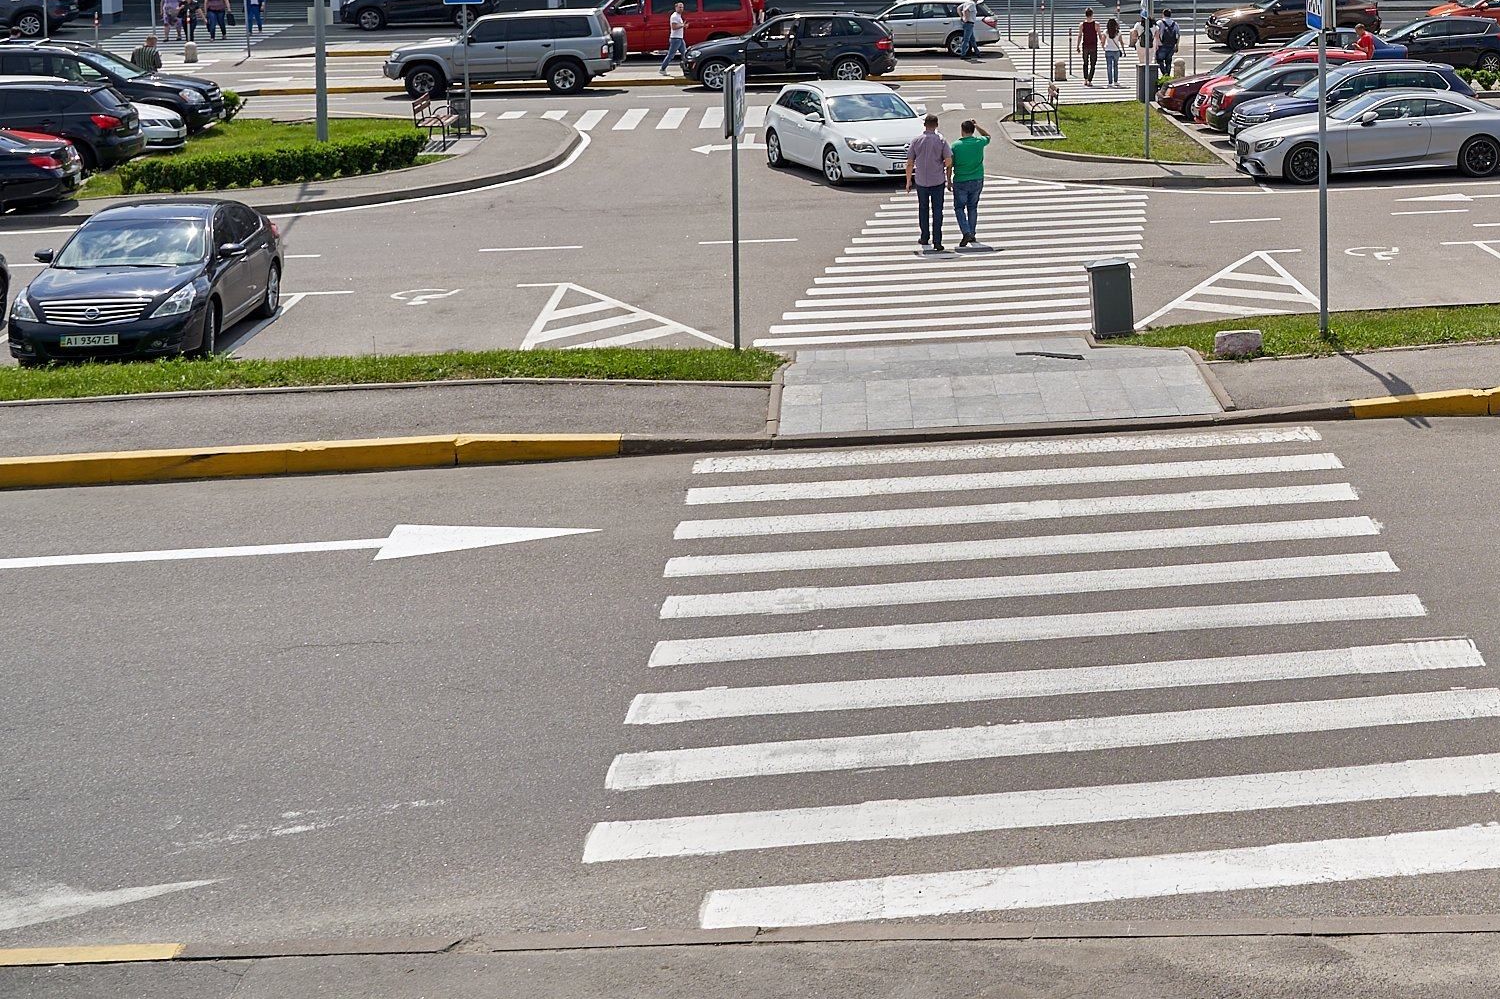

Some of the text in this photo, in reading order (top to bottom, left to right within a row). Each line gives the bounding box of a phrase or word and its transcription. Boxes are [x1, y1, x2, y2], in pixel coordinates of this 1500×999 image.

[66, 335, 114, 346] AI 9347 EI
